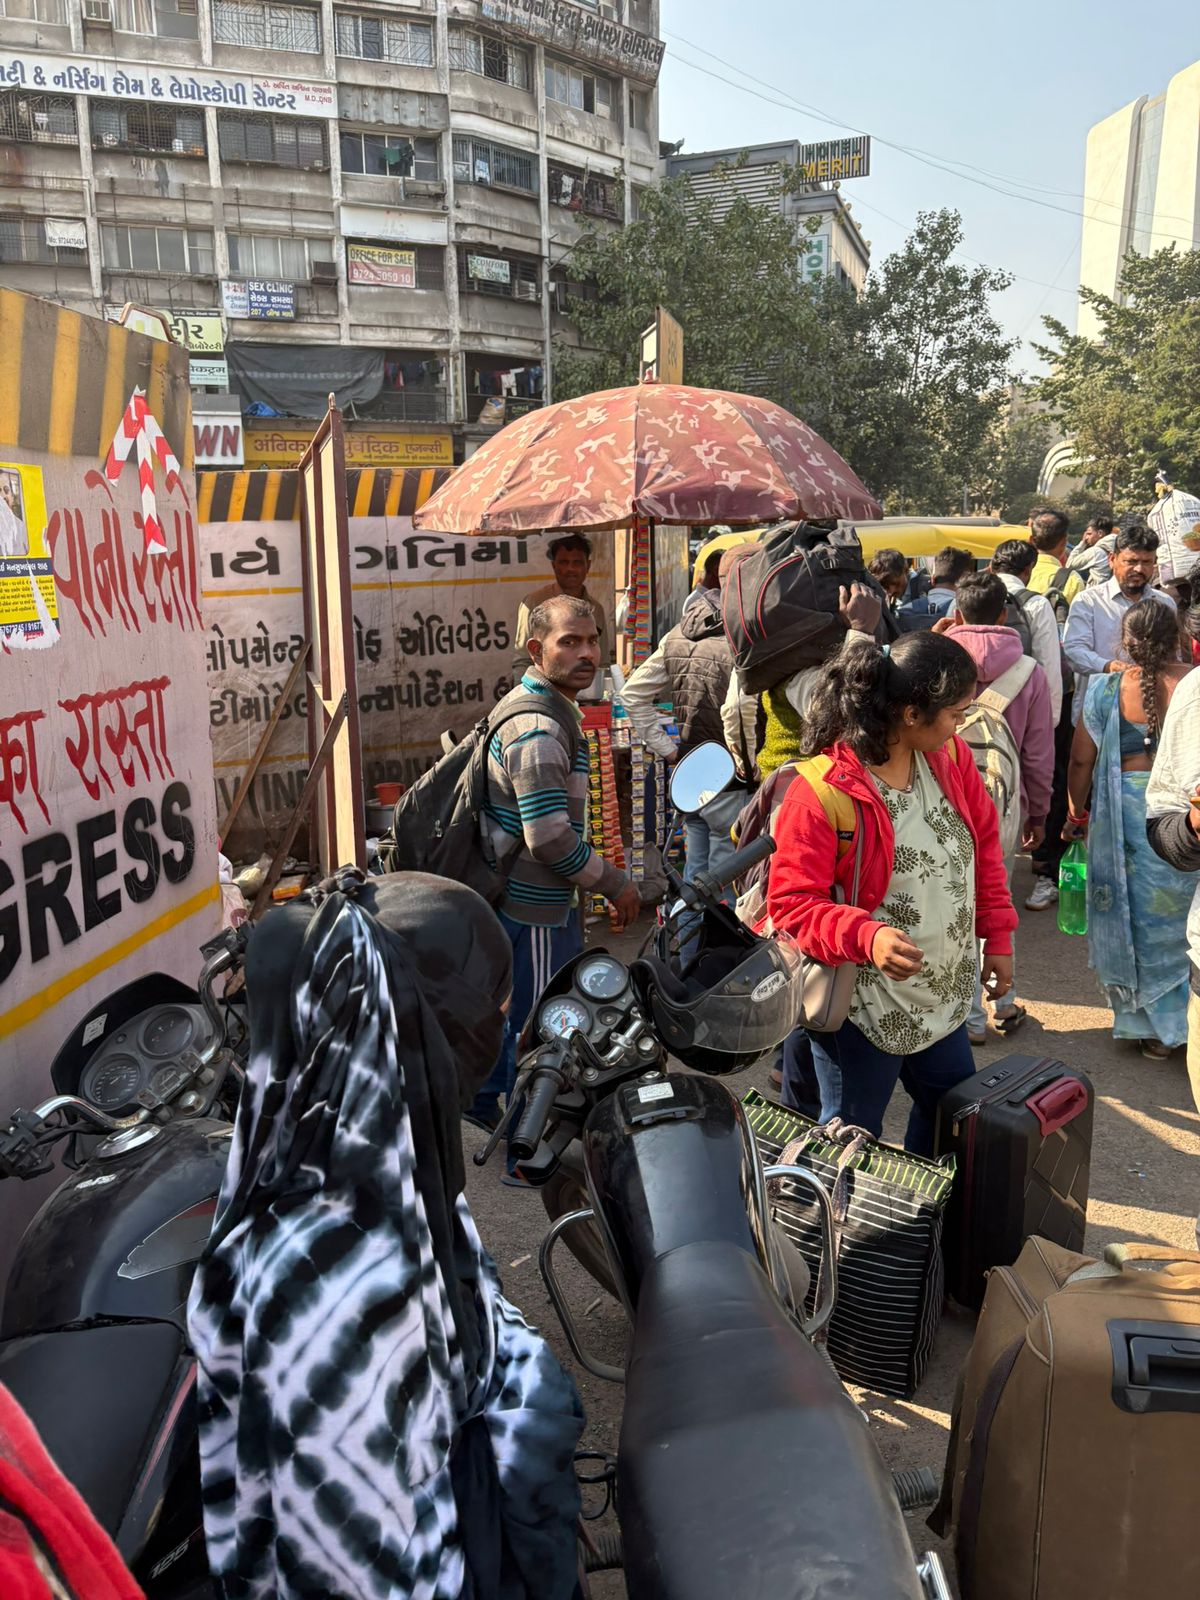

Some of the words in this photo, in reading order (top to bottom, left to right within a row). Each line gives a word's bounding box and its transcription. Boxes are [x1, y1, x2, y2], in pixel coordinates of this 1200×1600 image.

[33, 65, 46, 86] &
[53, 66, 106, 92] નર્સિંગ
[112, 70, 145, 95] હોમ
[150, 77, 164, 97] &
[169, 76, 248, 105] લેપ્રોસ્કોપી
[252, 84, 297, 110] સેન્ટર
[806, 138, 861, 160] HOTEL
[802, 155, 863, 177] MERIT
[350, 249, 376, 262] OFFICE
[378, 251, 393, 264] FOR
[394, 253, 413, 265] SALE
[249, 281, 265, 292] SEX
[266, 282, 294, 294] CLINIC
[400, 273, 411, 285] 10
[194, 425, 241, 457] WN
[206, 620, 307, 671] ોપમેન્ટ
[399, 607, 510, 656] એલિવેટેડ
[359, 669, 484, 713] ન્સપોર્ટેશન
